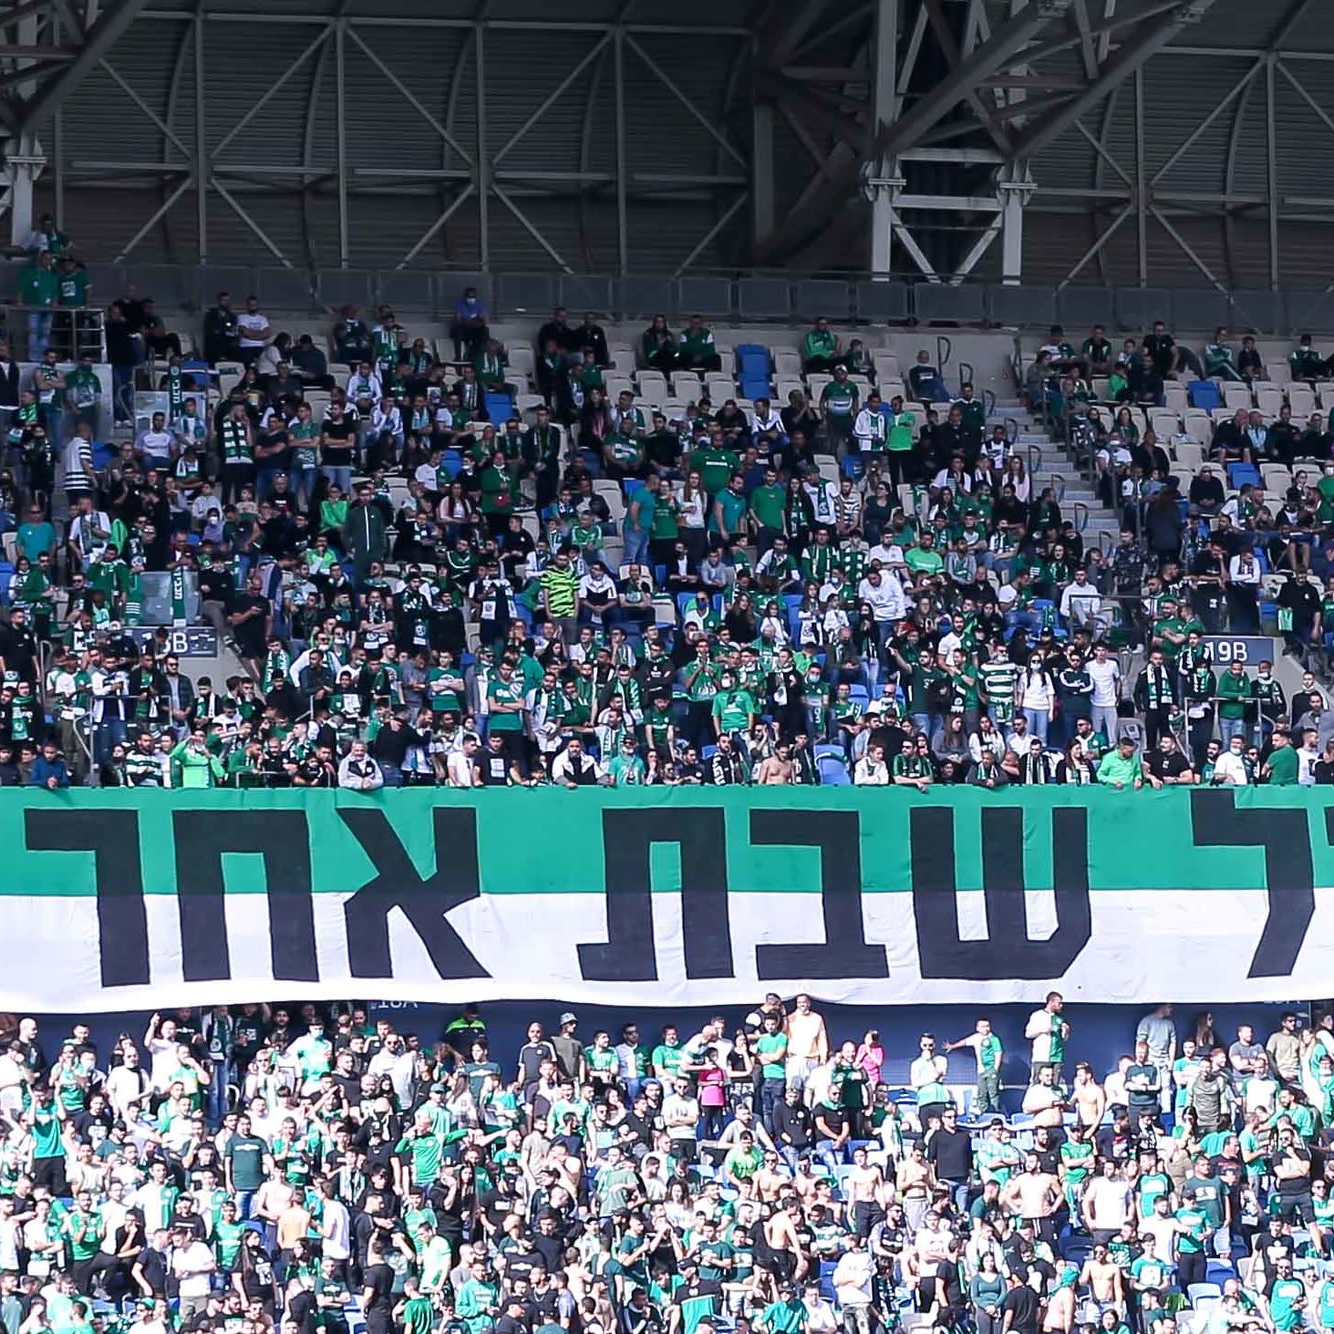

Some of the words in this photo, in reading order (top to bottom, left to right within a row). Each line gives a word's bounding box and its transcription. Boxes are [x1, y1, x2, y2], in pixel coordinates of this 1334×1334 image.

[1204, 641, 1248, 662] 19B
[24, 806, 492, 986] אחר
[576, 806, 1092, 982] שבת
